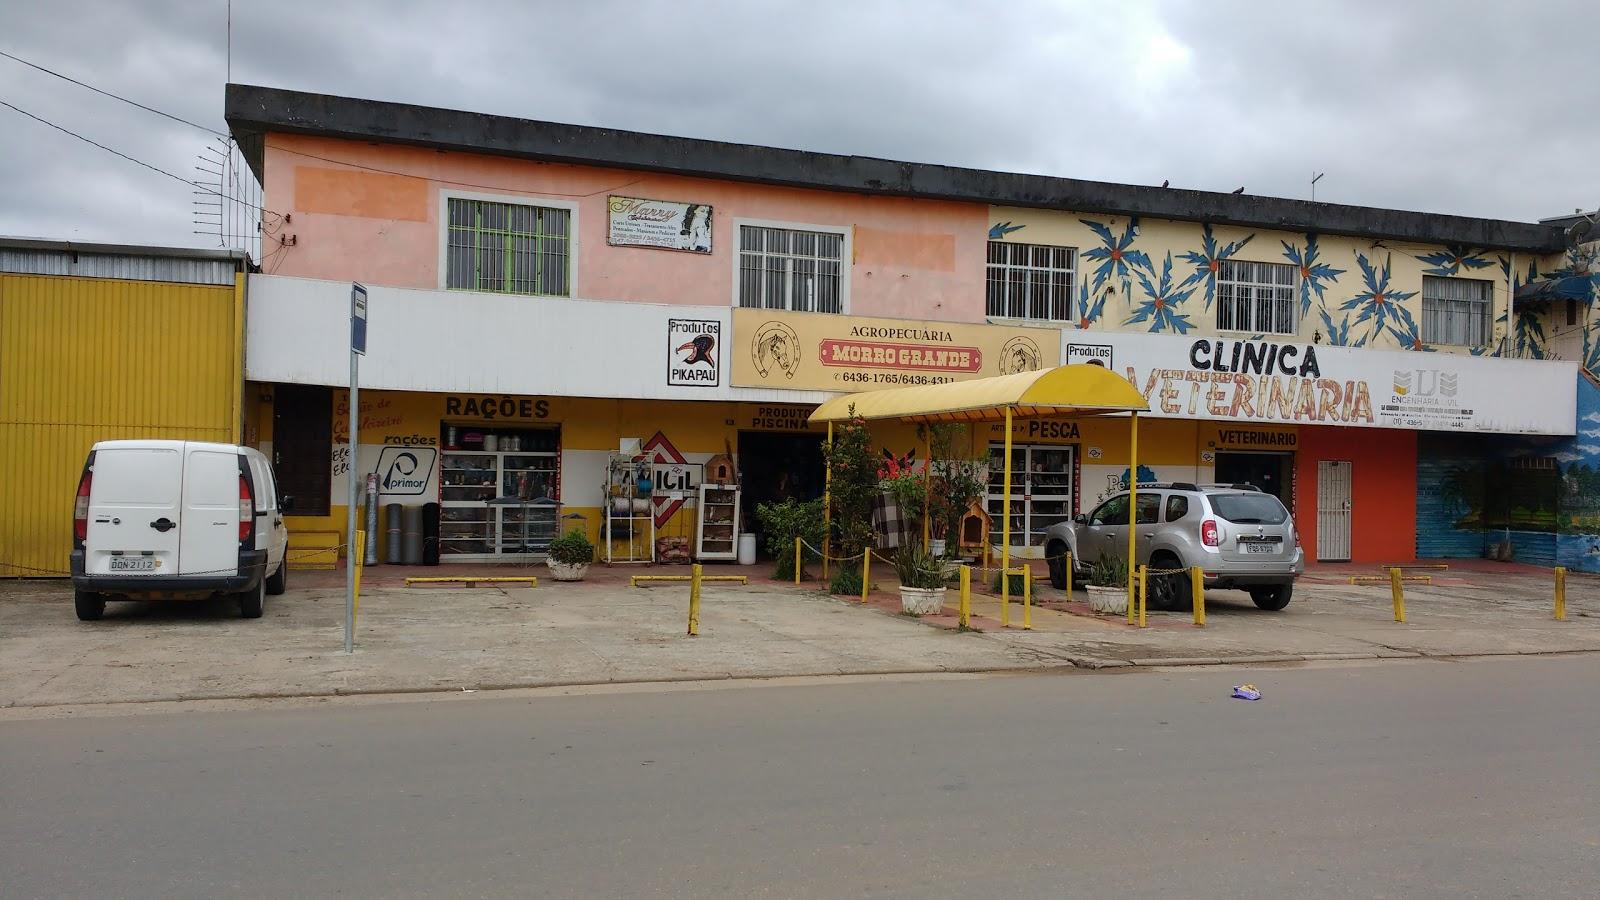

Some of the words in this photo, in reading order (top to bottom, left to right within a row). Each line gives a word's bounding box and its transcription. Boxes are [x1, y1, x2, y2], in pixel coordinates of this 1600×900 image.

[671, 322, 718, 334] Produtos
[850, 326, 953, 342] AGROPECUÁRIA
[832, 344, 896, 364] MORRO
[899, 349, 970, 367] GRANDE
[1069, 346, 1110, 358] Produtos
[672, 369, 716, 381] PIKAPAU
[759, 407, 812, 419] PRODUTO
[1029, 420, 1080, 439] PESCA
[384, 433, 437, 447] rações
[1218, 429, 1297, 446] VETERINARIO
[390, 477, 425, 490] primor
